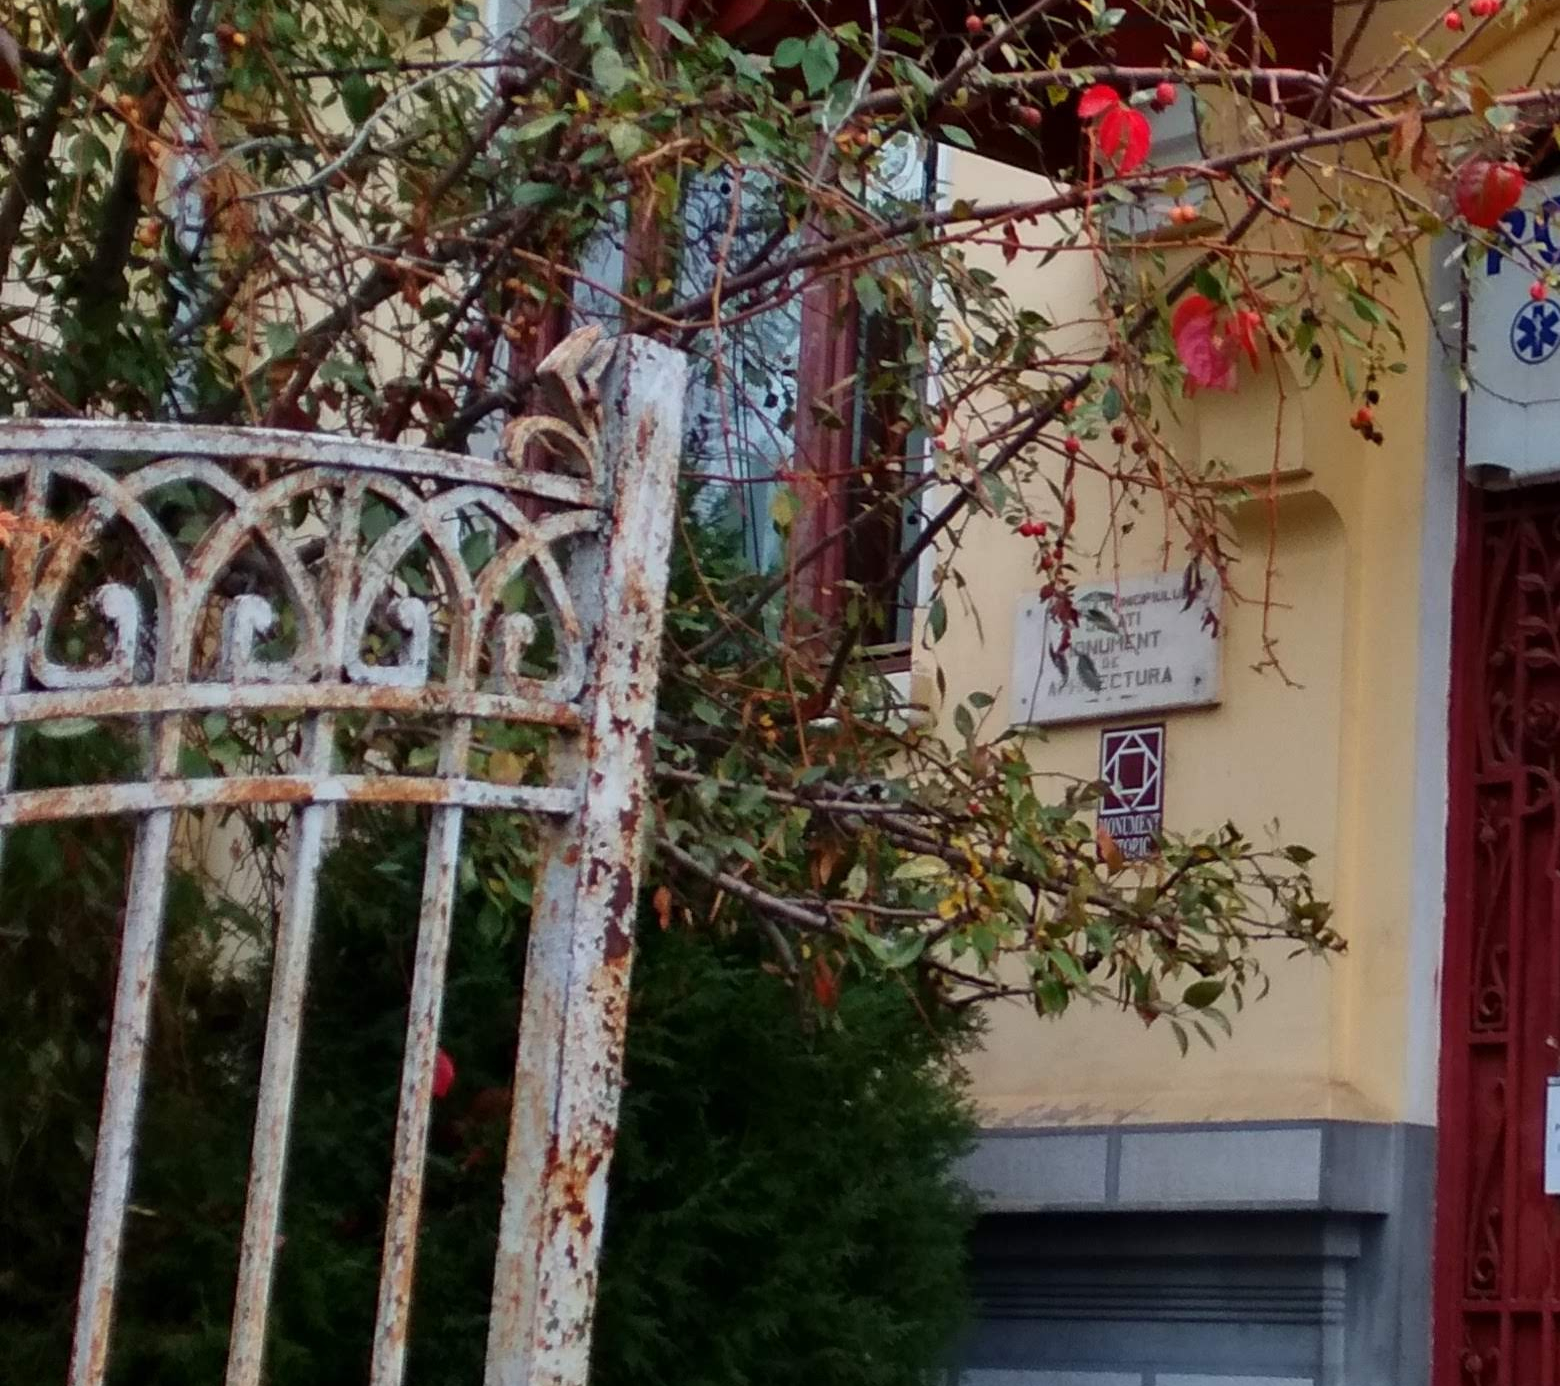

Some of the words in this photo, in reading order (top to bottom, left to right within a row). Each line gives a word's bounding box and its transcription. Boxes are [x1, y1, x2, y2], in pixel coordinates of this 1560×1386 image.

[1062, 630, 1161, 657] ONUMENT
[1048, 666, 1172, 696] AECTURA
[1108, 835, 1152, 859] TORIC
